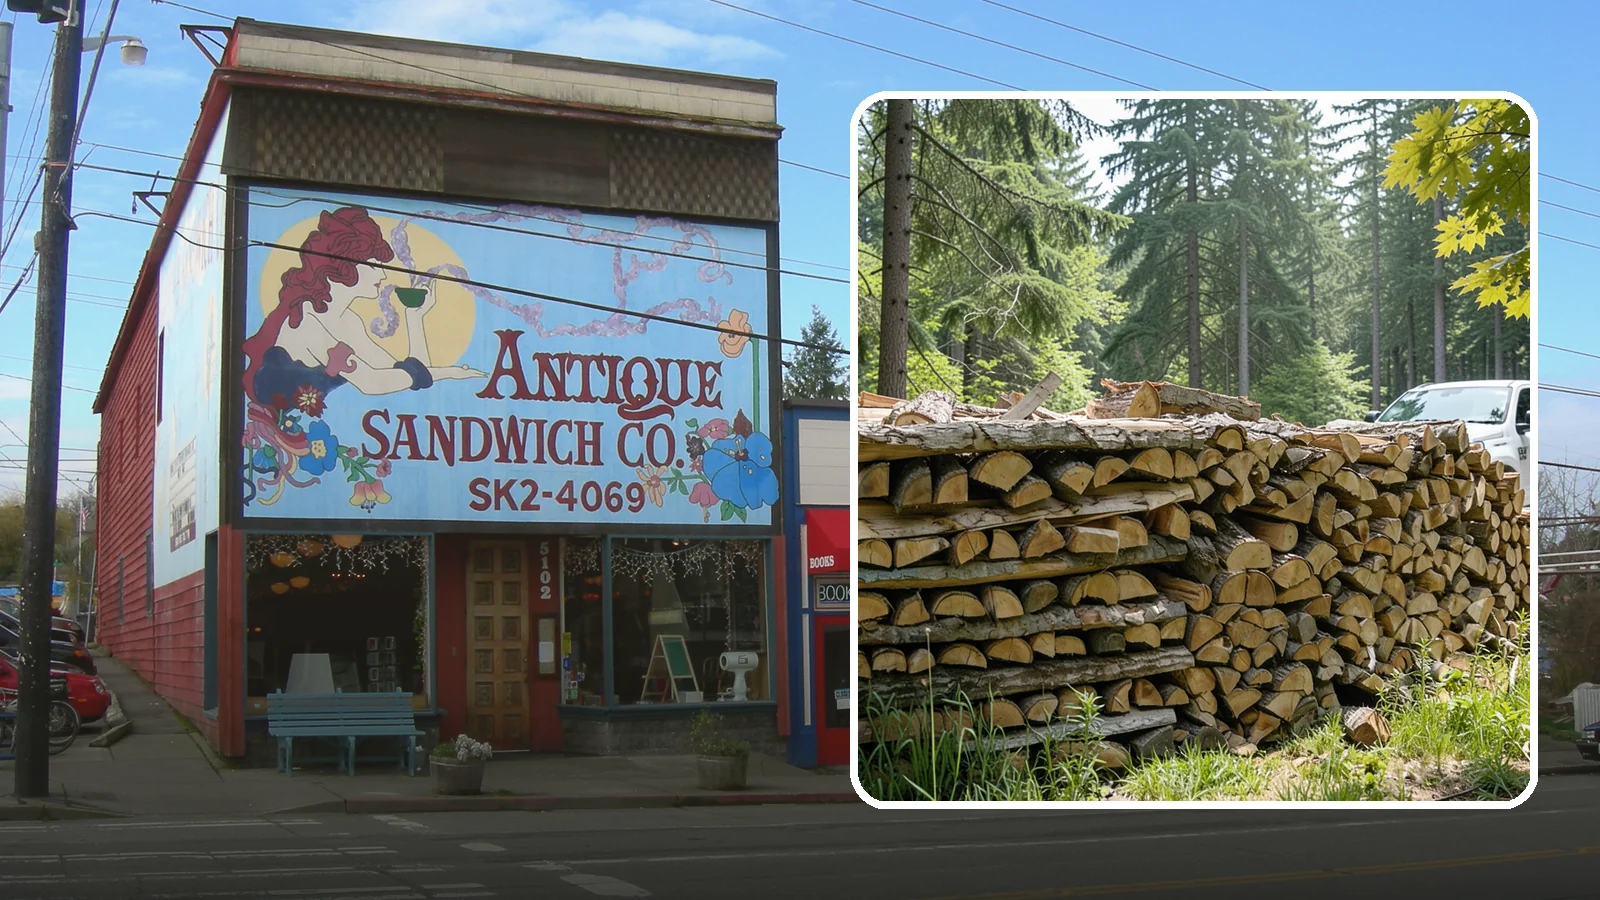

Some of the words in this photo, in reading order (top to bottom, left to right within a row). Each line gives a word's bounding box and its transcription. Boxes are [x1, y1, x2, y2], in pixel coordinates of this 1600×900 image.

[475, 329, 723, 421] ANTIQUE
[361, 408, 604, 467] SANDWICH
[617, 422, 685, 468] CO.
[468, 477, 646, 513] SK2-4069
[540, 541, 551, 600] 5102
[809, 555, 835, 569] BOOKS
